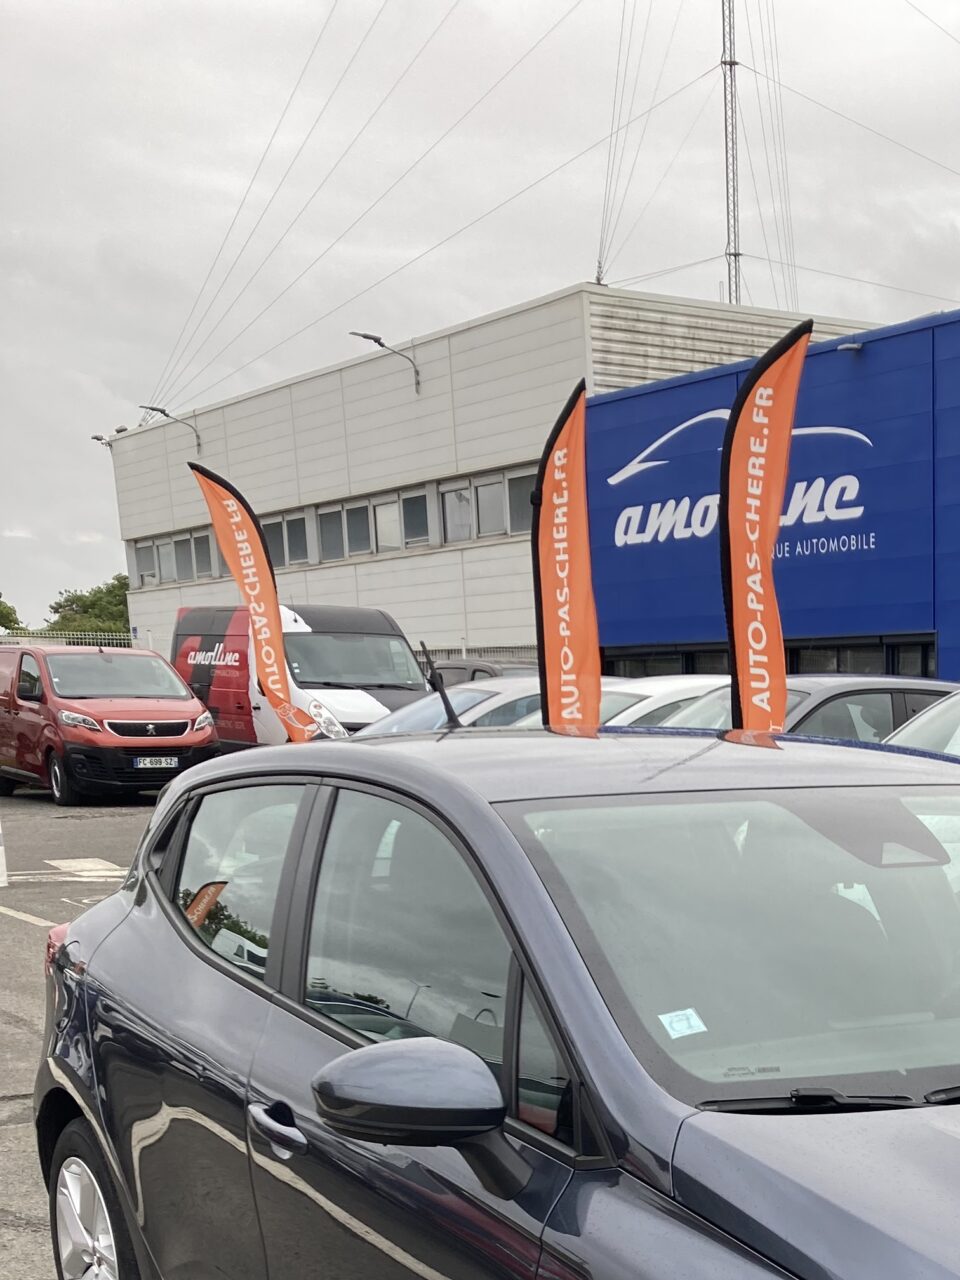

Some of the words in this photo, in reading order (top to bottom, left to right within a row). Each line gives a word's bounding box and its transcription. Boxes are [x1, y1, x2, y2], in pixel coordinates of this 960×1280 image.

[552, 447, 582, 720] AUTO-PAS-CHERE.FR
[745, 385, 774, 713] AUTO-PAS-CHERE.FR
[795, 532, 876, 556] AUTOMOBILE
